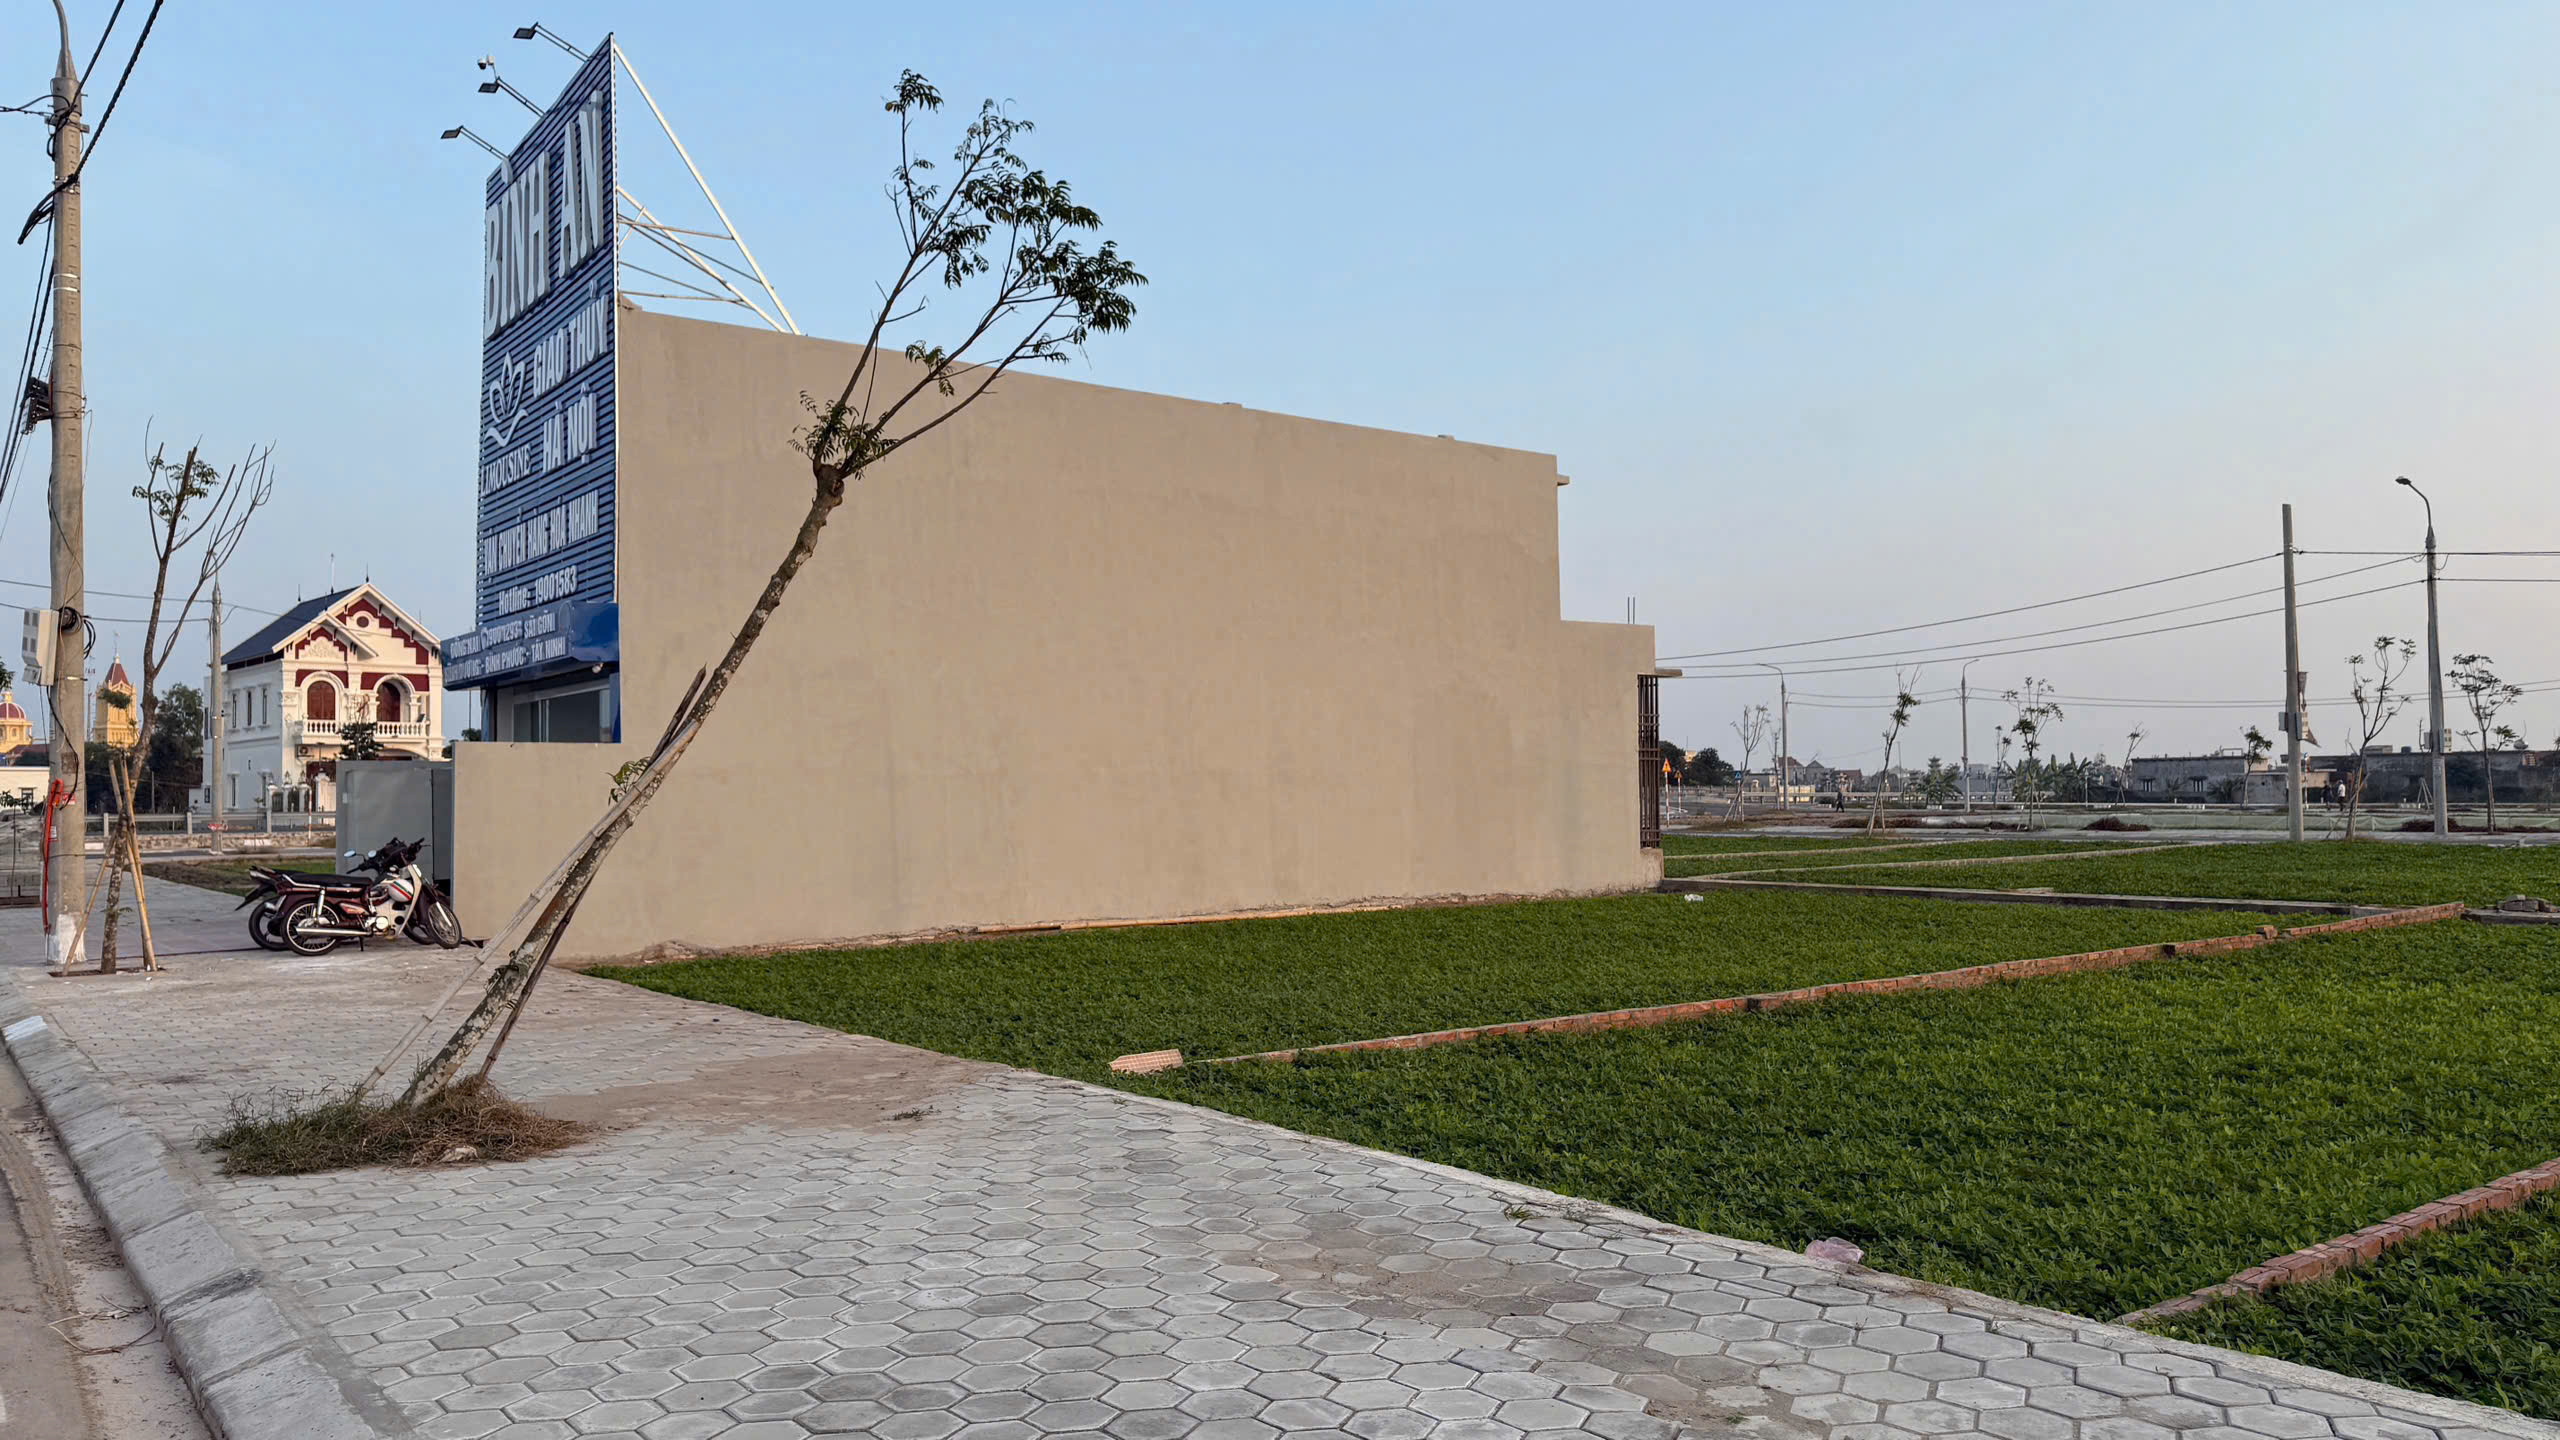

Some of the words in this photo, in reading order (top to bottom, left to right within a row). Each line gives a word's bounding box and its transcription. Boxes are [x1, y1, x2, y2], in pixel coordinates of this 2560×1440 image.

[484, 158, 549, 340] BÌNH
[559, 89, 603, 278] AN
[533, 328, 568, 398] GIAO
[542, 401, 565, 473] HÀ
[567, 381, 598, 464] NỘI
[480, 443, 531, 498] LIMOUSINE
[527, 508, 548, 560] HÀNG
[568, 489, 599, 545] NHANH
[499, 586, 531, 615] Hotline:
[535, 565, 577, 605] 19001583
[524, 615, 537, 639] SÀI
[537, 610, 556, 635] GÒN
[545, 636, 566, 660] NINH
